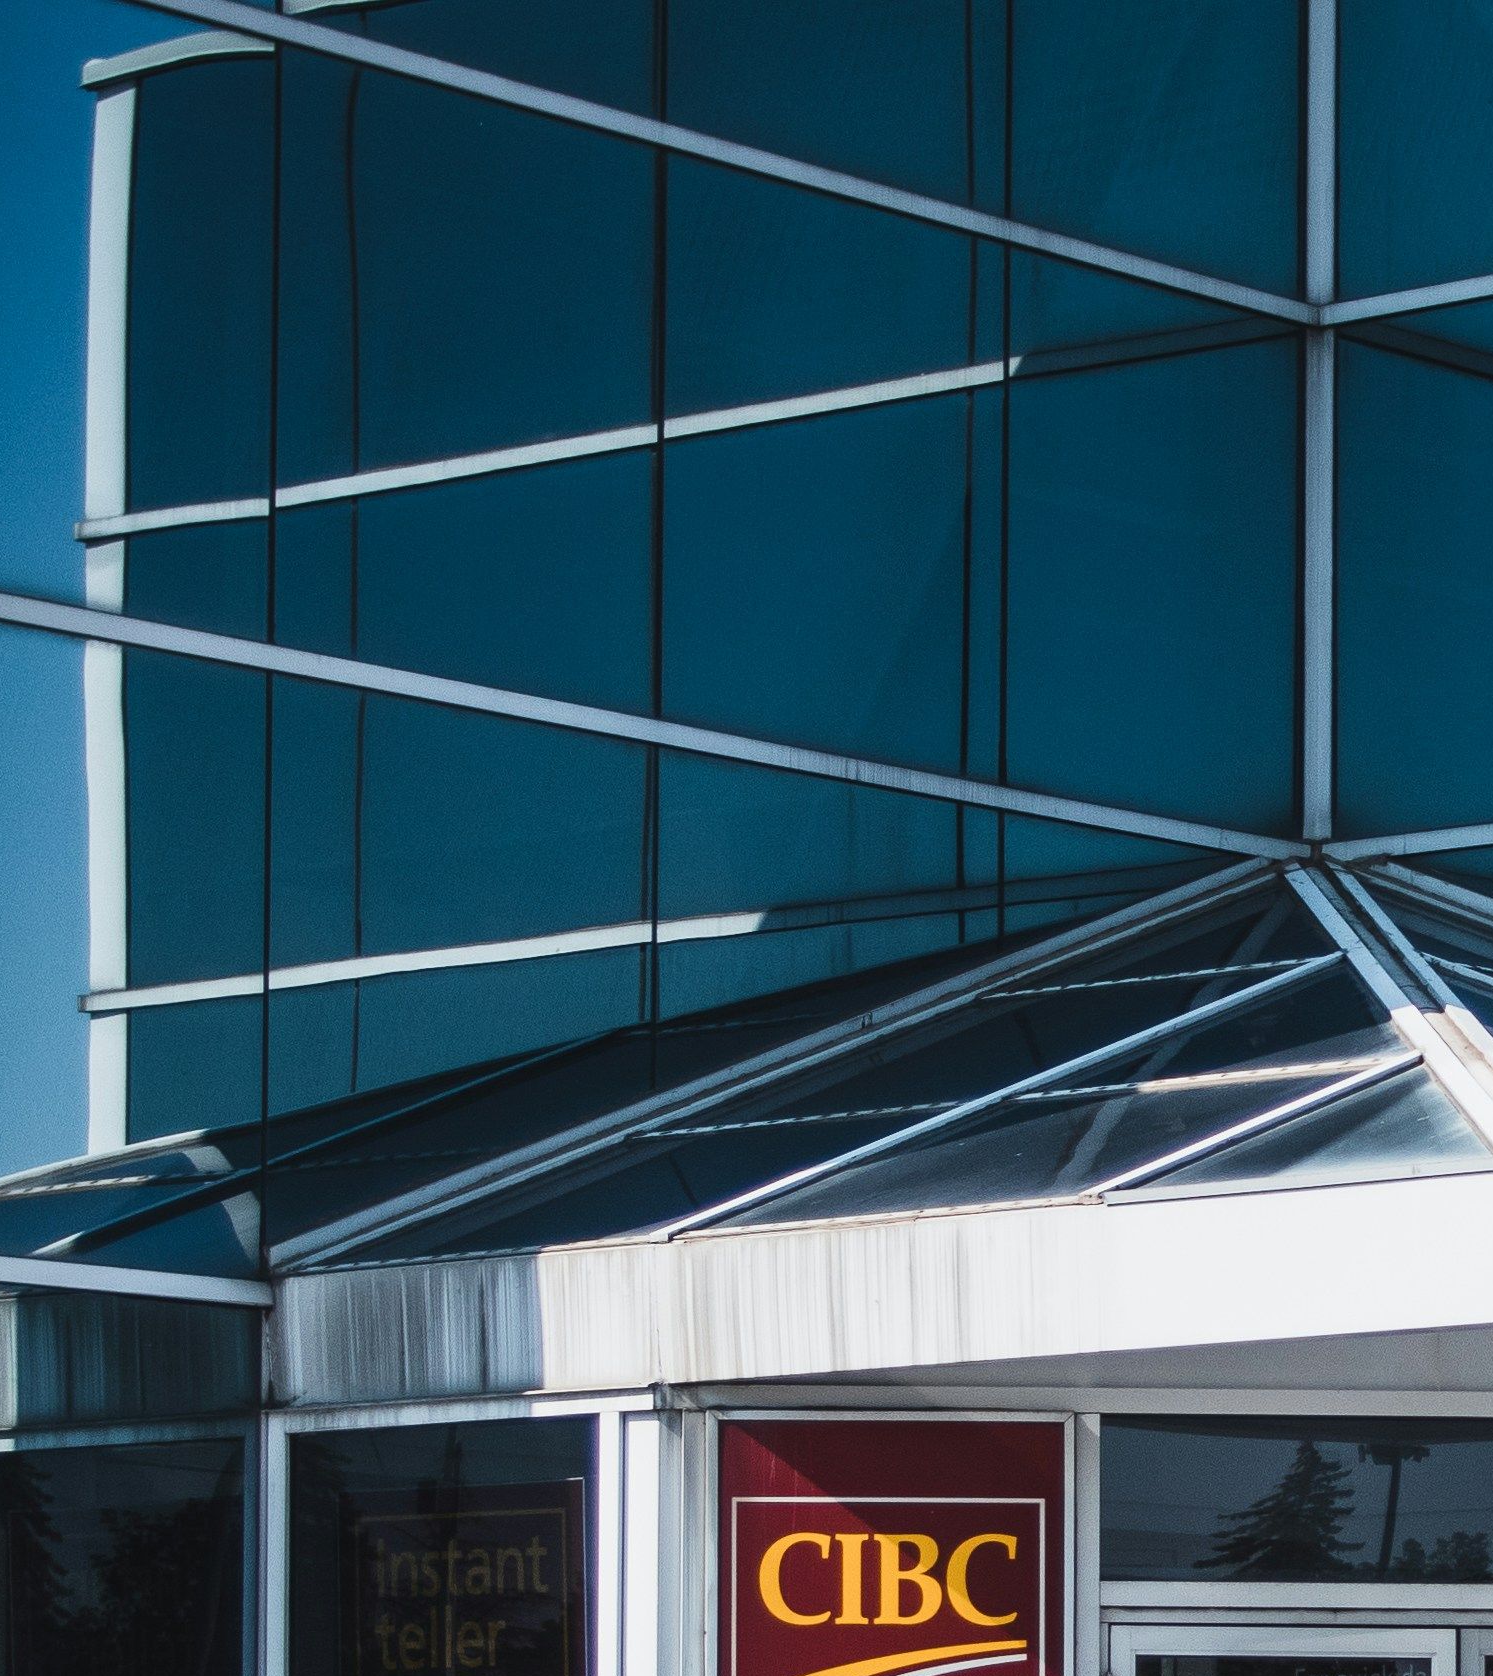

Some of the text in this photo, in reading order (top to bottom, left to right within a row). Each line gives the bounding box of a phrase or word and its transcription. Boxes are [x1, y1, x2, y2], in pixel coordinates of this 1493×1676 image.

[375, 1535, 549, 1598] instant
[758, 1532, 1018, 1626] CIBC
[375, 1604, 506, 1671] teller
